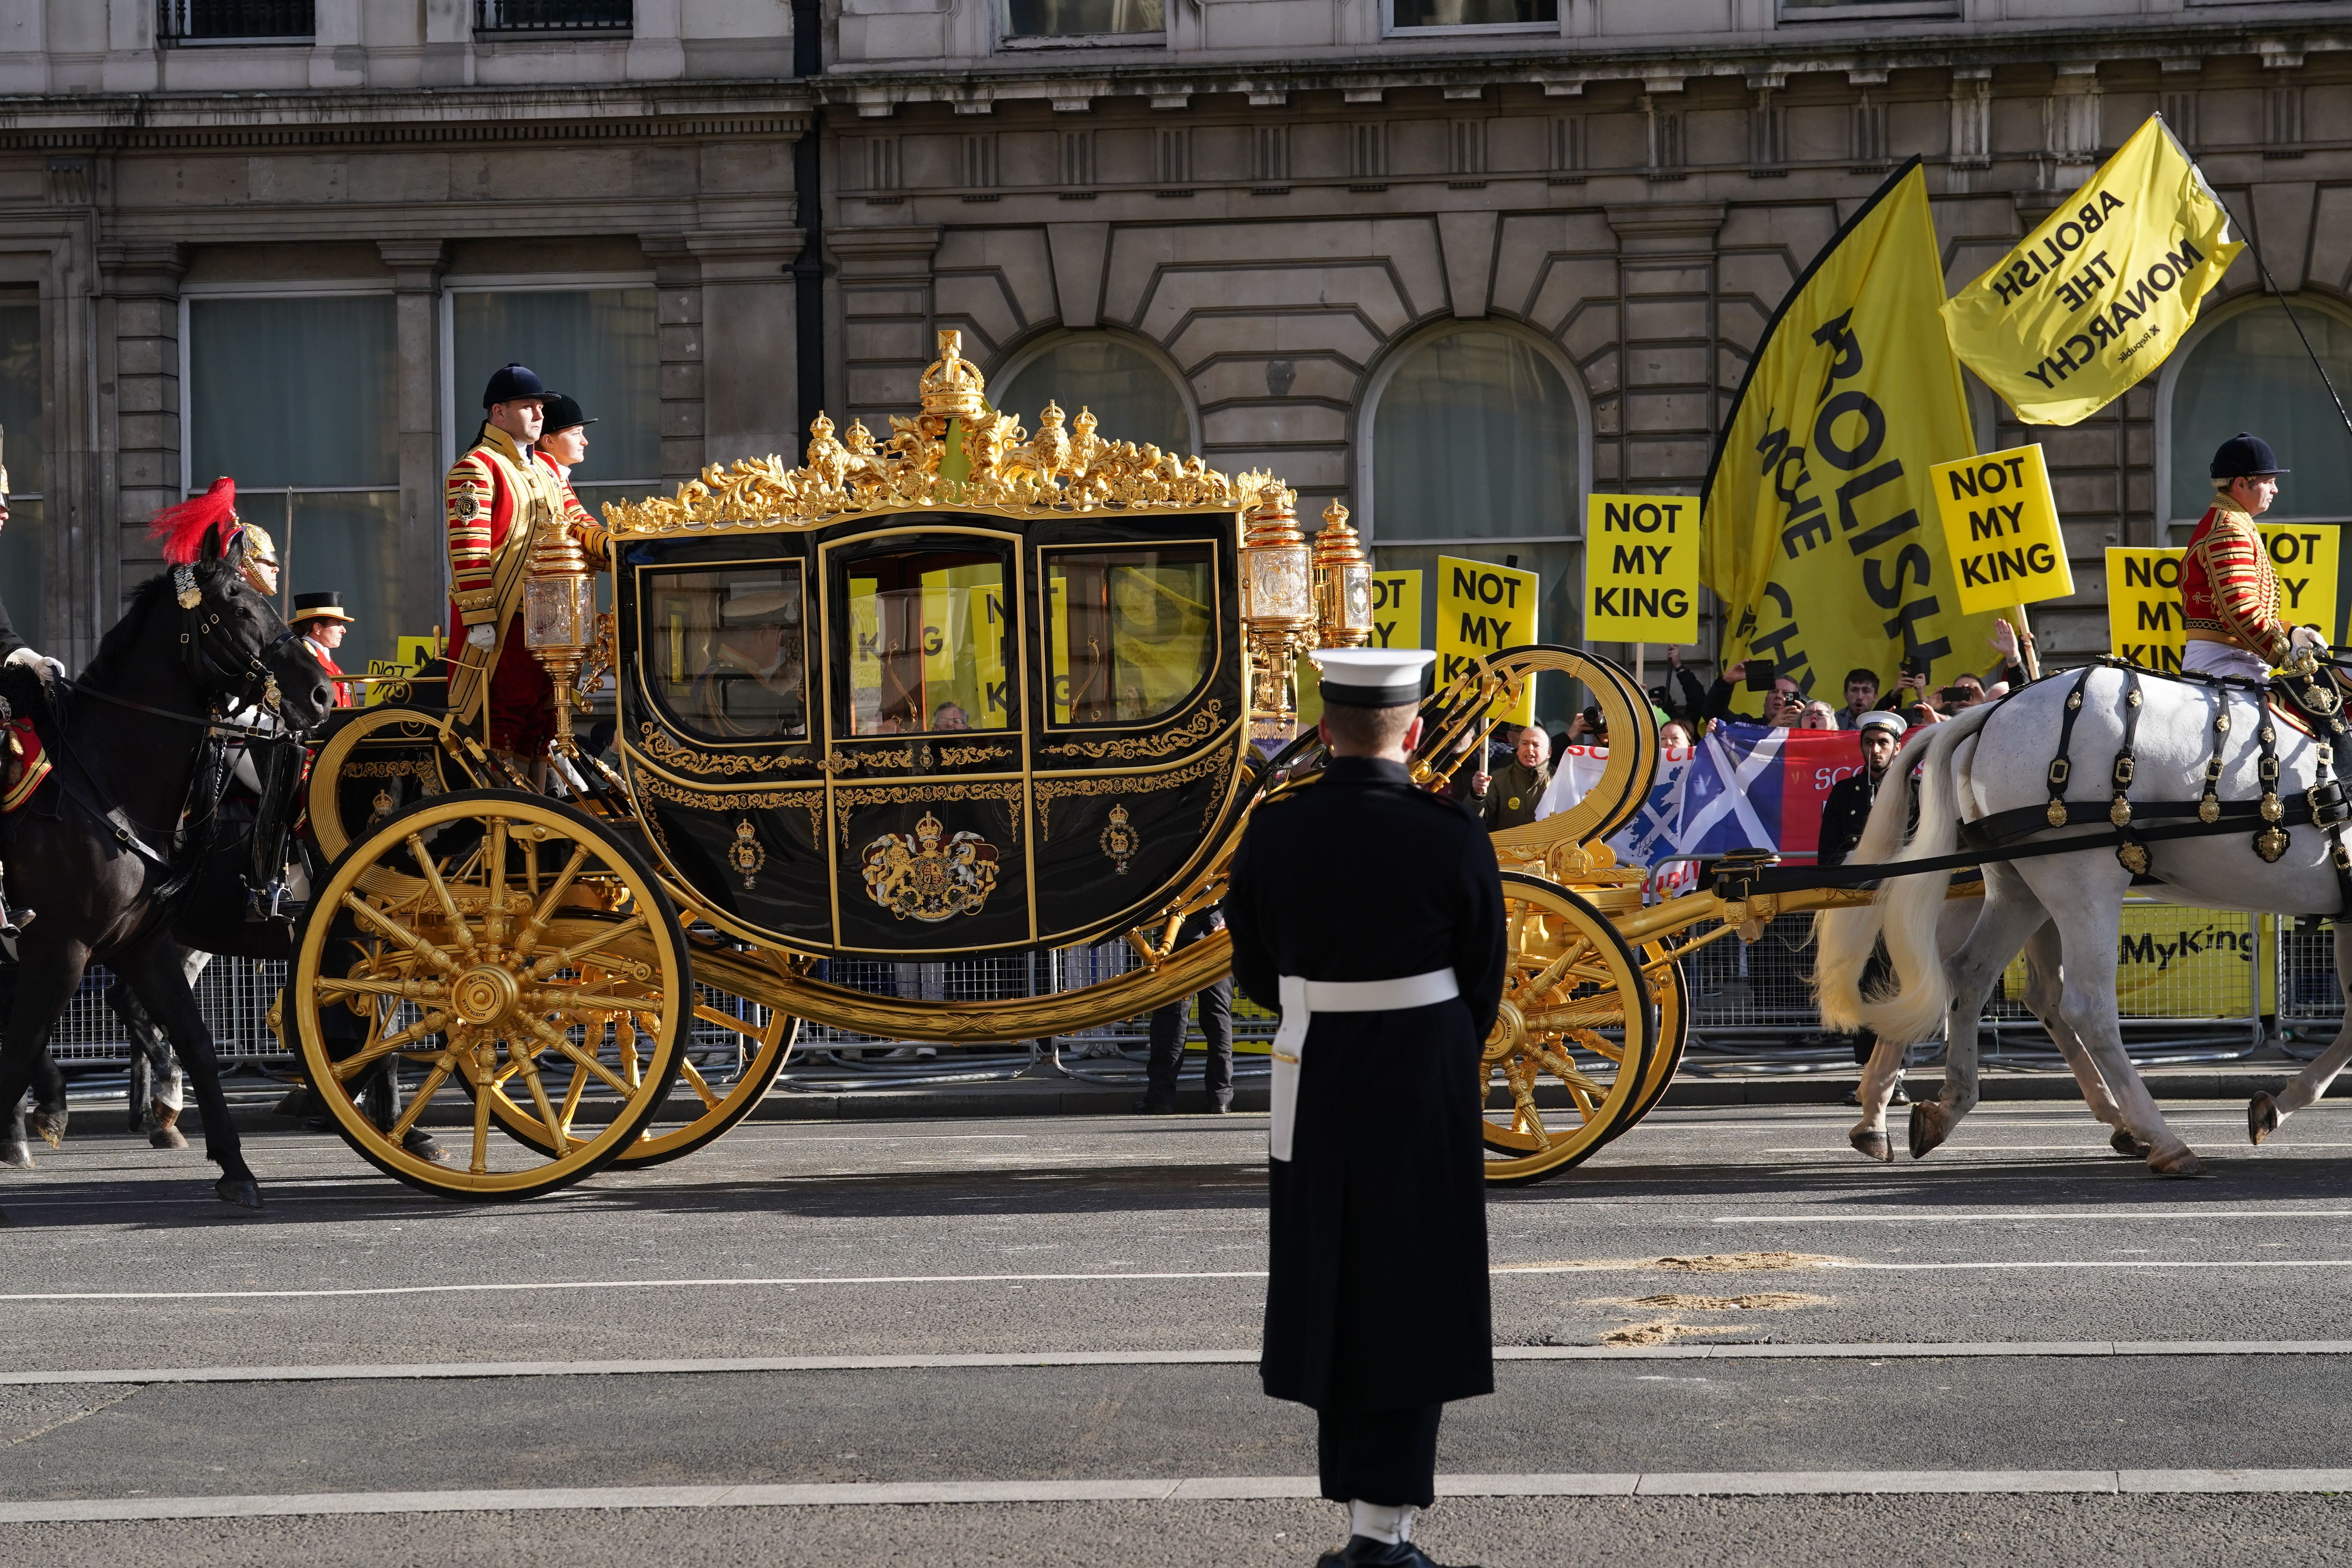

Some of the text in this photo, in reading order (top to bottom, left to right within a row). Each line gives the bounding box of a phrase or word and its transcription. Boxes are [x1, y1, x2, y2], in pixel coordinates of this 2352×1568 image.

[1948, 457, 2024, 501] NOT
[1604, 503, 1682, 534] NOT
[1969, 501, 2024, 541] MY
[1613, 545, 1671, 575] MY
[1960, 543, 2056, 588] KING
[2125, 557, 2180, 588] NO
[1372, 579, 1406, 610] OT
[1453, 567, 1521, 609] NOT
[1595, 587, 1689, 619] KING
[1460, 612, 1512, 650] MY
[2122, 644, 2186, 675] KIN
[462, 998, 486, 1017] AUSTRALIA
